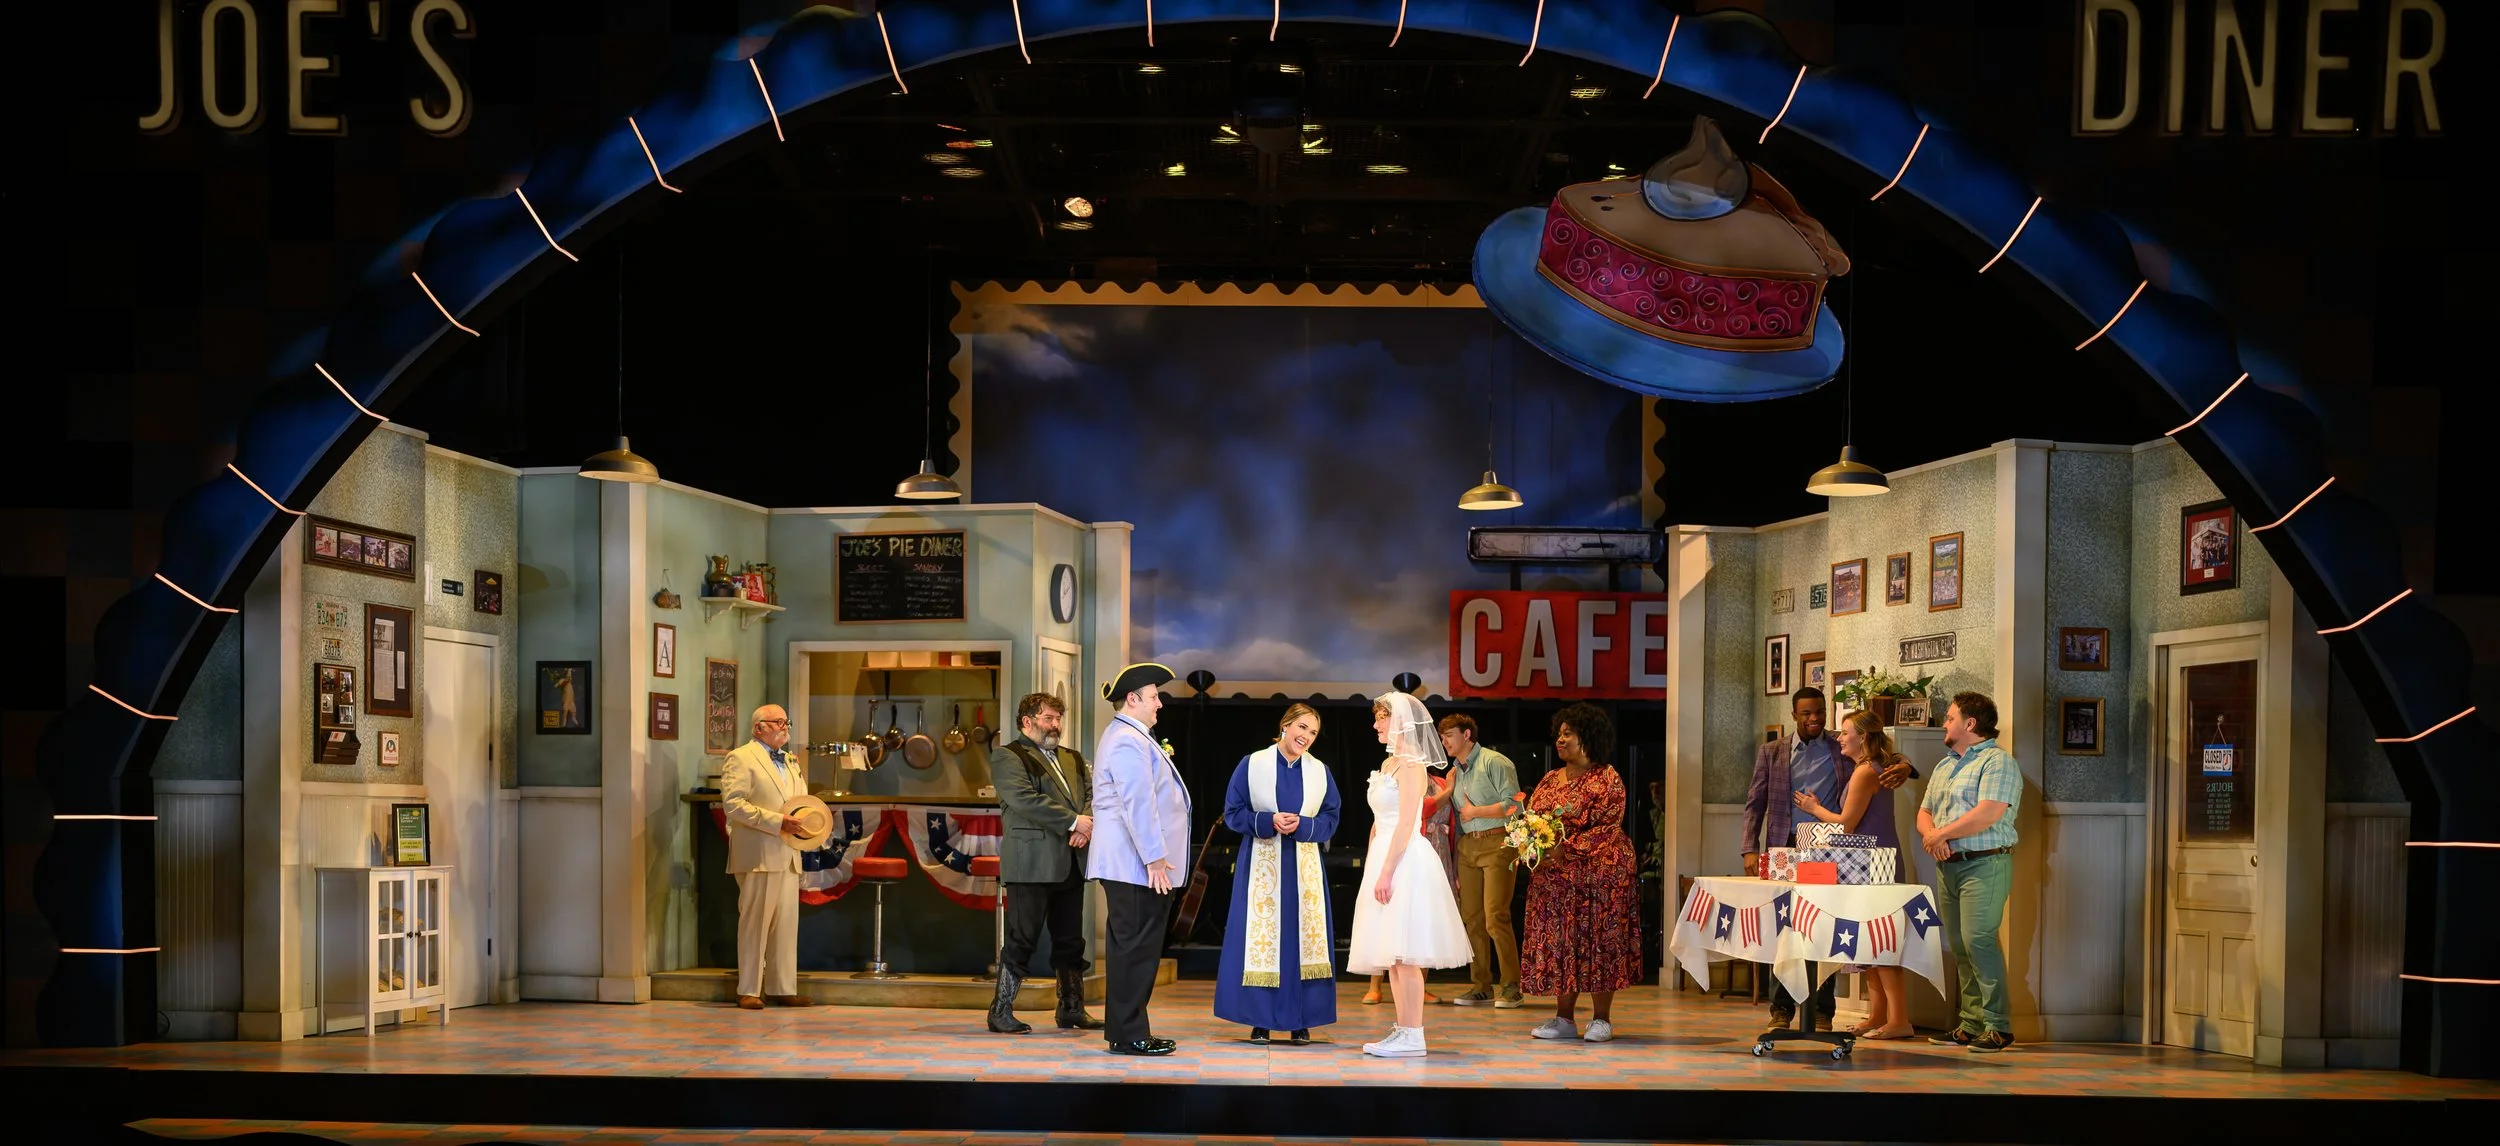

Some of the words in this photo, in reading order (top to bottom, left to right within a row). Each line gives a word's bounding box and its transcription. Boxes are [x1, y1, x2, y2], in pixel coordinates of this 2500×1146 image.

[139, 0, 468, 131] JOE'S
[2081, 0, 2447, 132] DINER
[841, 535, 882, 557] JOE'S
[889, 537, 916, 557] PIE
[920, 536, 962, 557] DINER
[658, 639, 671, 668] A
[1460, 598, 1667, 688] CAFE
[2205, 750, 2222, 763] CLOSED
